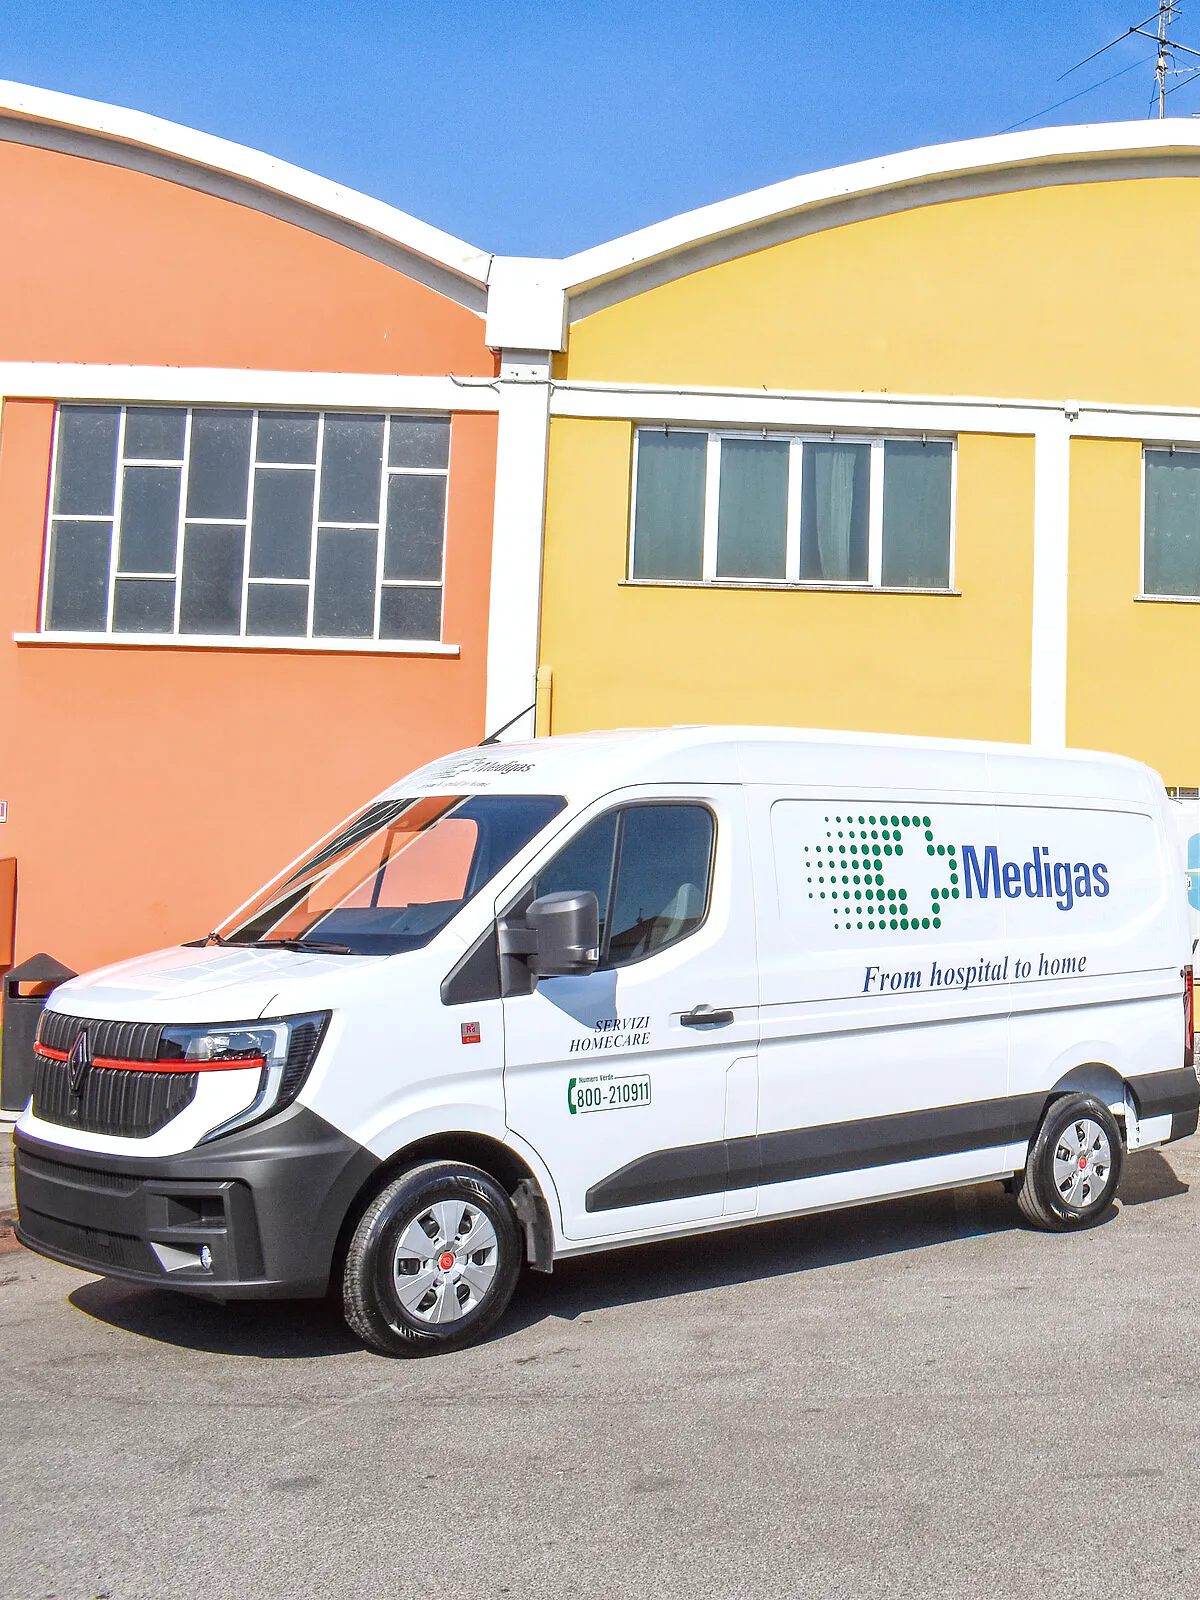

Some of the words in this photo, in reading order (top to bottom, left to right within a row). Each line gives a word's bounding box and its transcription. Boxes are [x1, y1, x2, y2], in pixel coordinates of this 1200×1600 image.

[961, 845, 1110, 912] Medigas
[861, 965, 922, 993] From
[929, 955, 1009, 992] hospital
[1014, 957, 1032, 979] to
[1037, 952, 1087, 977] home
[594, 1015, 651, 1034] SERVIZI
[569, 1031, 651, 1053] HOMECARE
[599, 1073, 614, 1082] Verde
[577, 1082, 649, 1108] 800-210911
